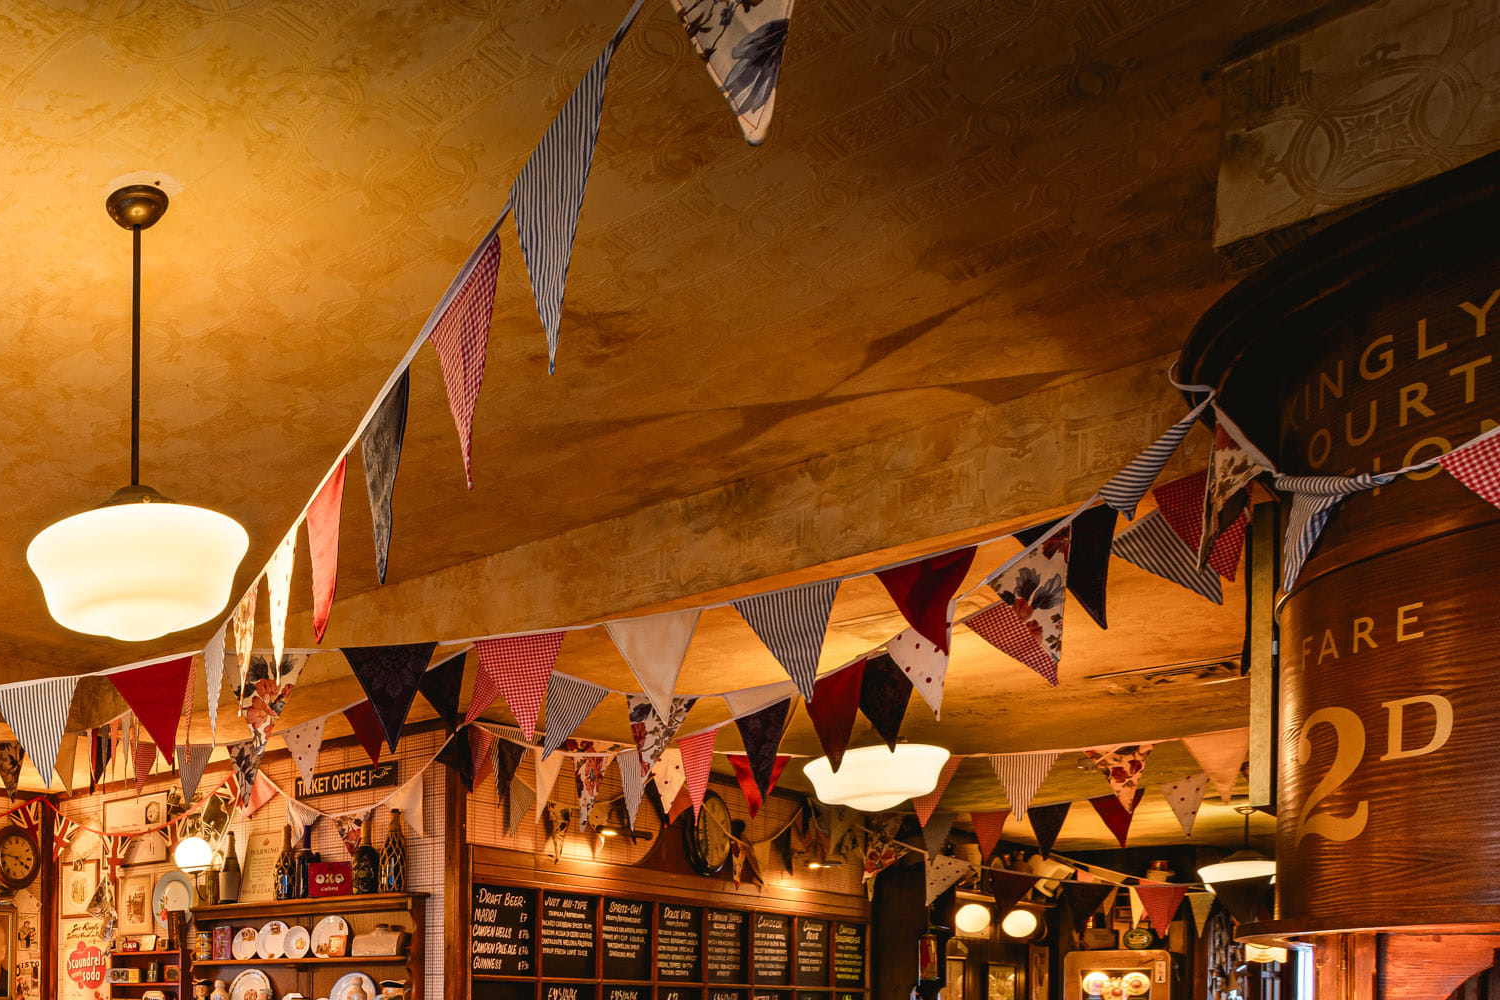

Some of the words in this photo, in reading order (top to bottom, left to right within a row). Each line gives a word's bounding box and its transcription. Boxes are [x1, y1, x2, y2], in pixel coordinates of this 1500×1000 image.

[1283, 288, 1500, 434] KINGLY
[1282, 355, 1493, 469] OURT
[1301, 602, 1425, 671] FARE
[332, 769, 367, 790] OFFICE
[315, 873, 345, 885] OXO
[68, 952, 105, 970] Scoundrel's
[82, 966, 100, 982] soda
